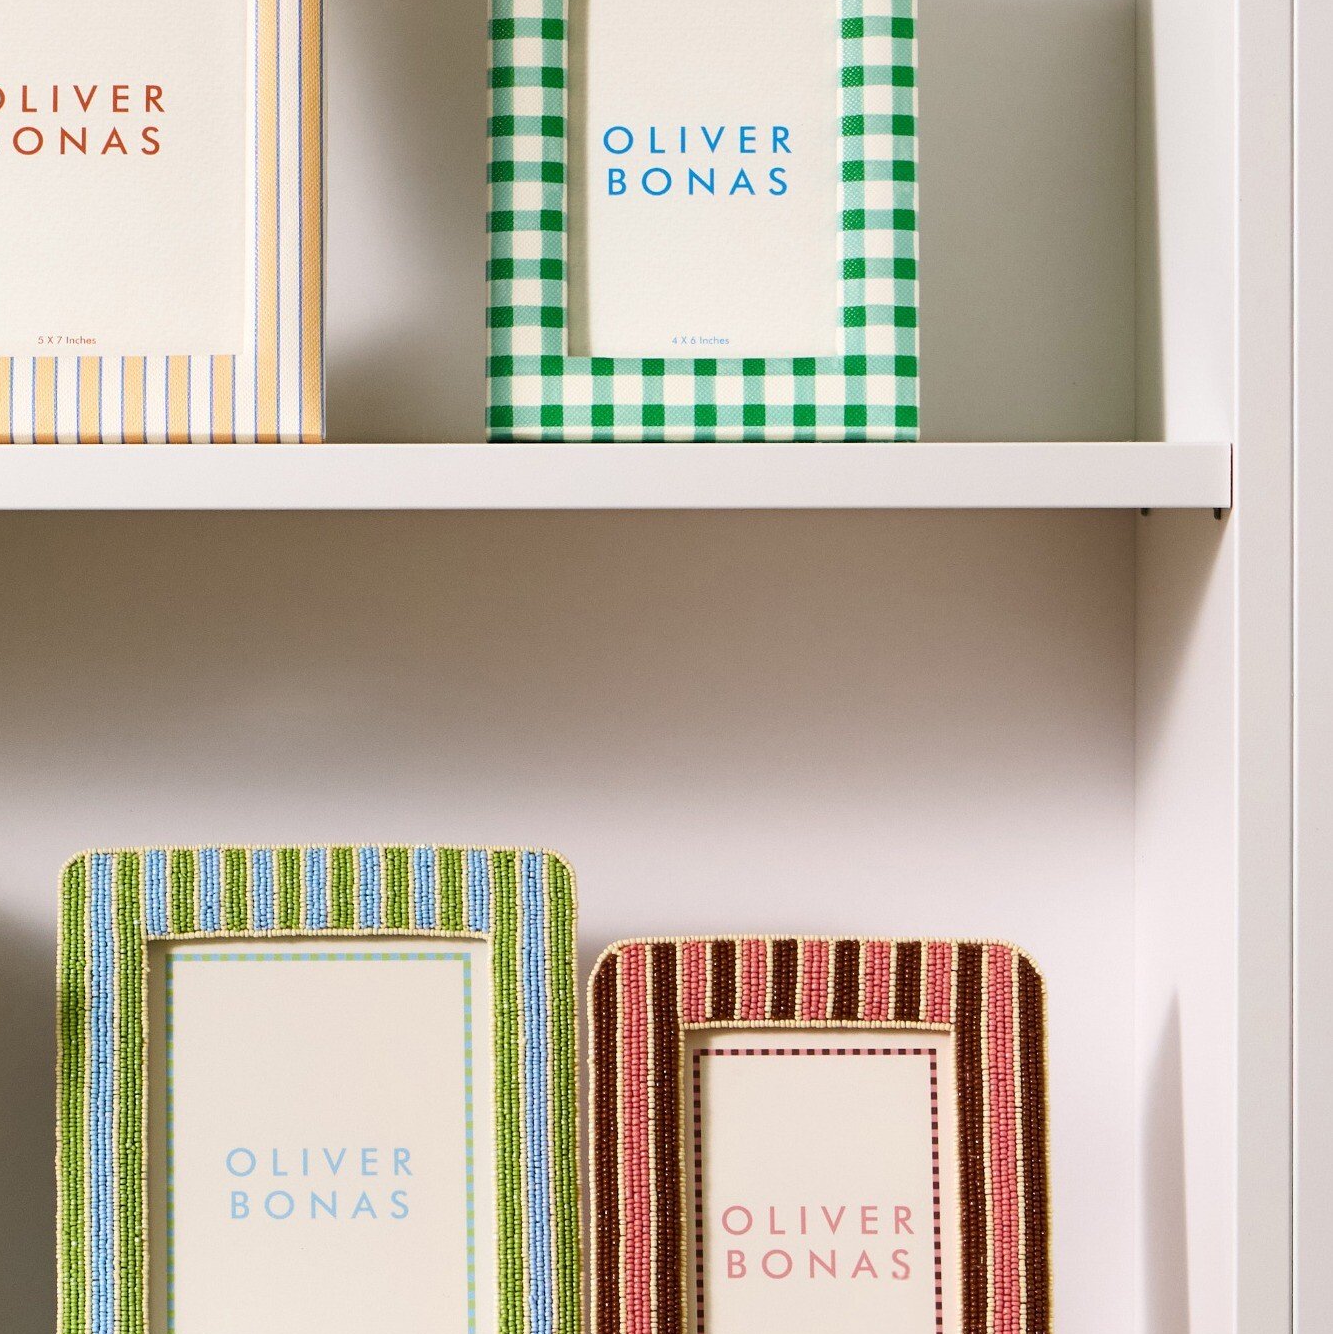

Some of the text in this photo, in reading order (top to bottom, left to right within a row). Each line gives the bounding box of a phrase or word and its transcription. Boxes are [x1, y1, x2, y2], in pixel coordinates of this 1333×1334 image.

[603, 126, 792, 154] OLIVER
[608, 167, 788, 196] BONAS
[66, 335, 96, 345] Inches
[699, 336, 730, 345] Inches
[225, 1147, 413, 1177] OLIVER
[230, 1190, 410, 1220] BONAS
[721, 1205, 914, 1235] OLIVER
[727, 1249, 911, 1280] BONAS
